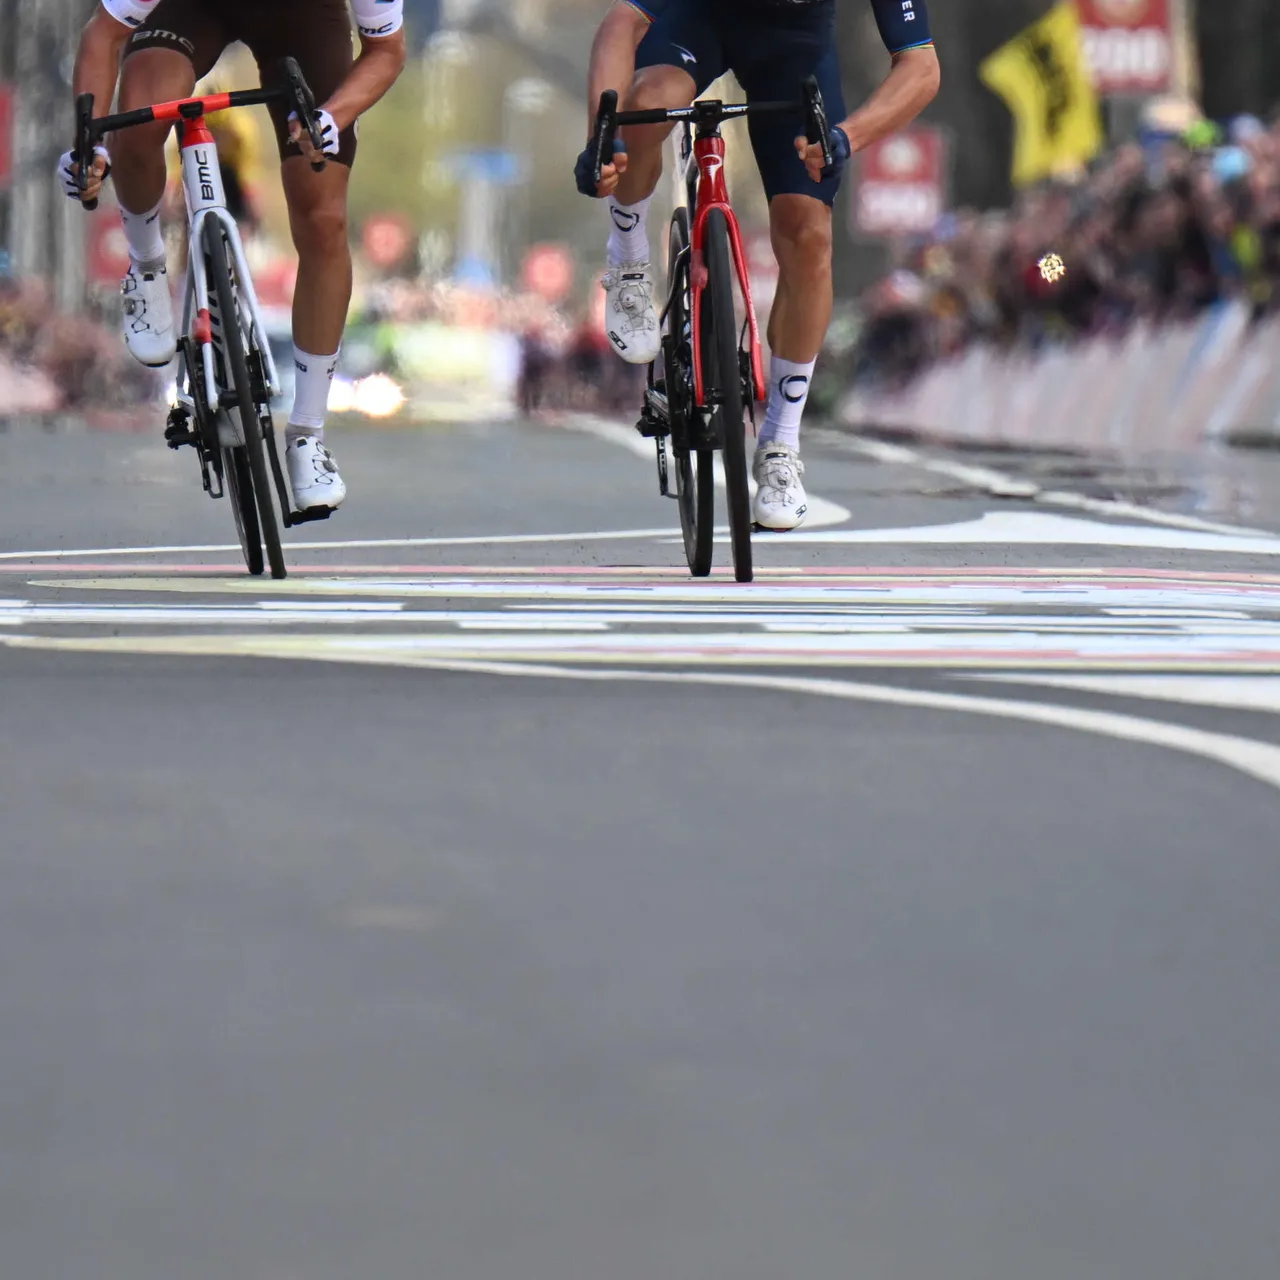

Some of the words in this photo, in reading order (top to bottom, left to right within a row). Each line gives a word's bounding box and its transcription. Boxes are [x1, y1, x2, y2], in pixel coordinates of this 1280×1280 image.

[131, 29, 195, 54] BMC
[666, 109, 694, 117] MOST
[722, 105, 750, 113] MOST
[194, 149, 214, 201] BMC
